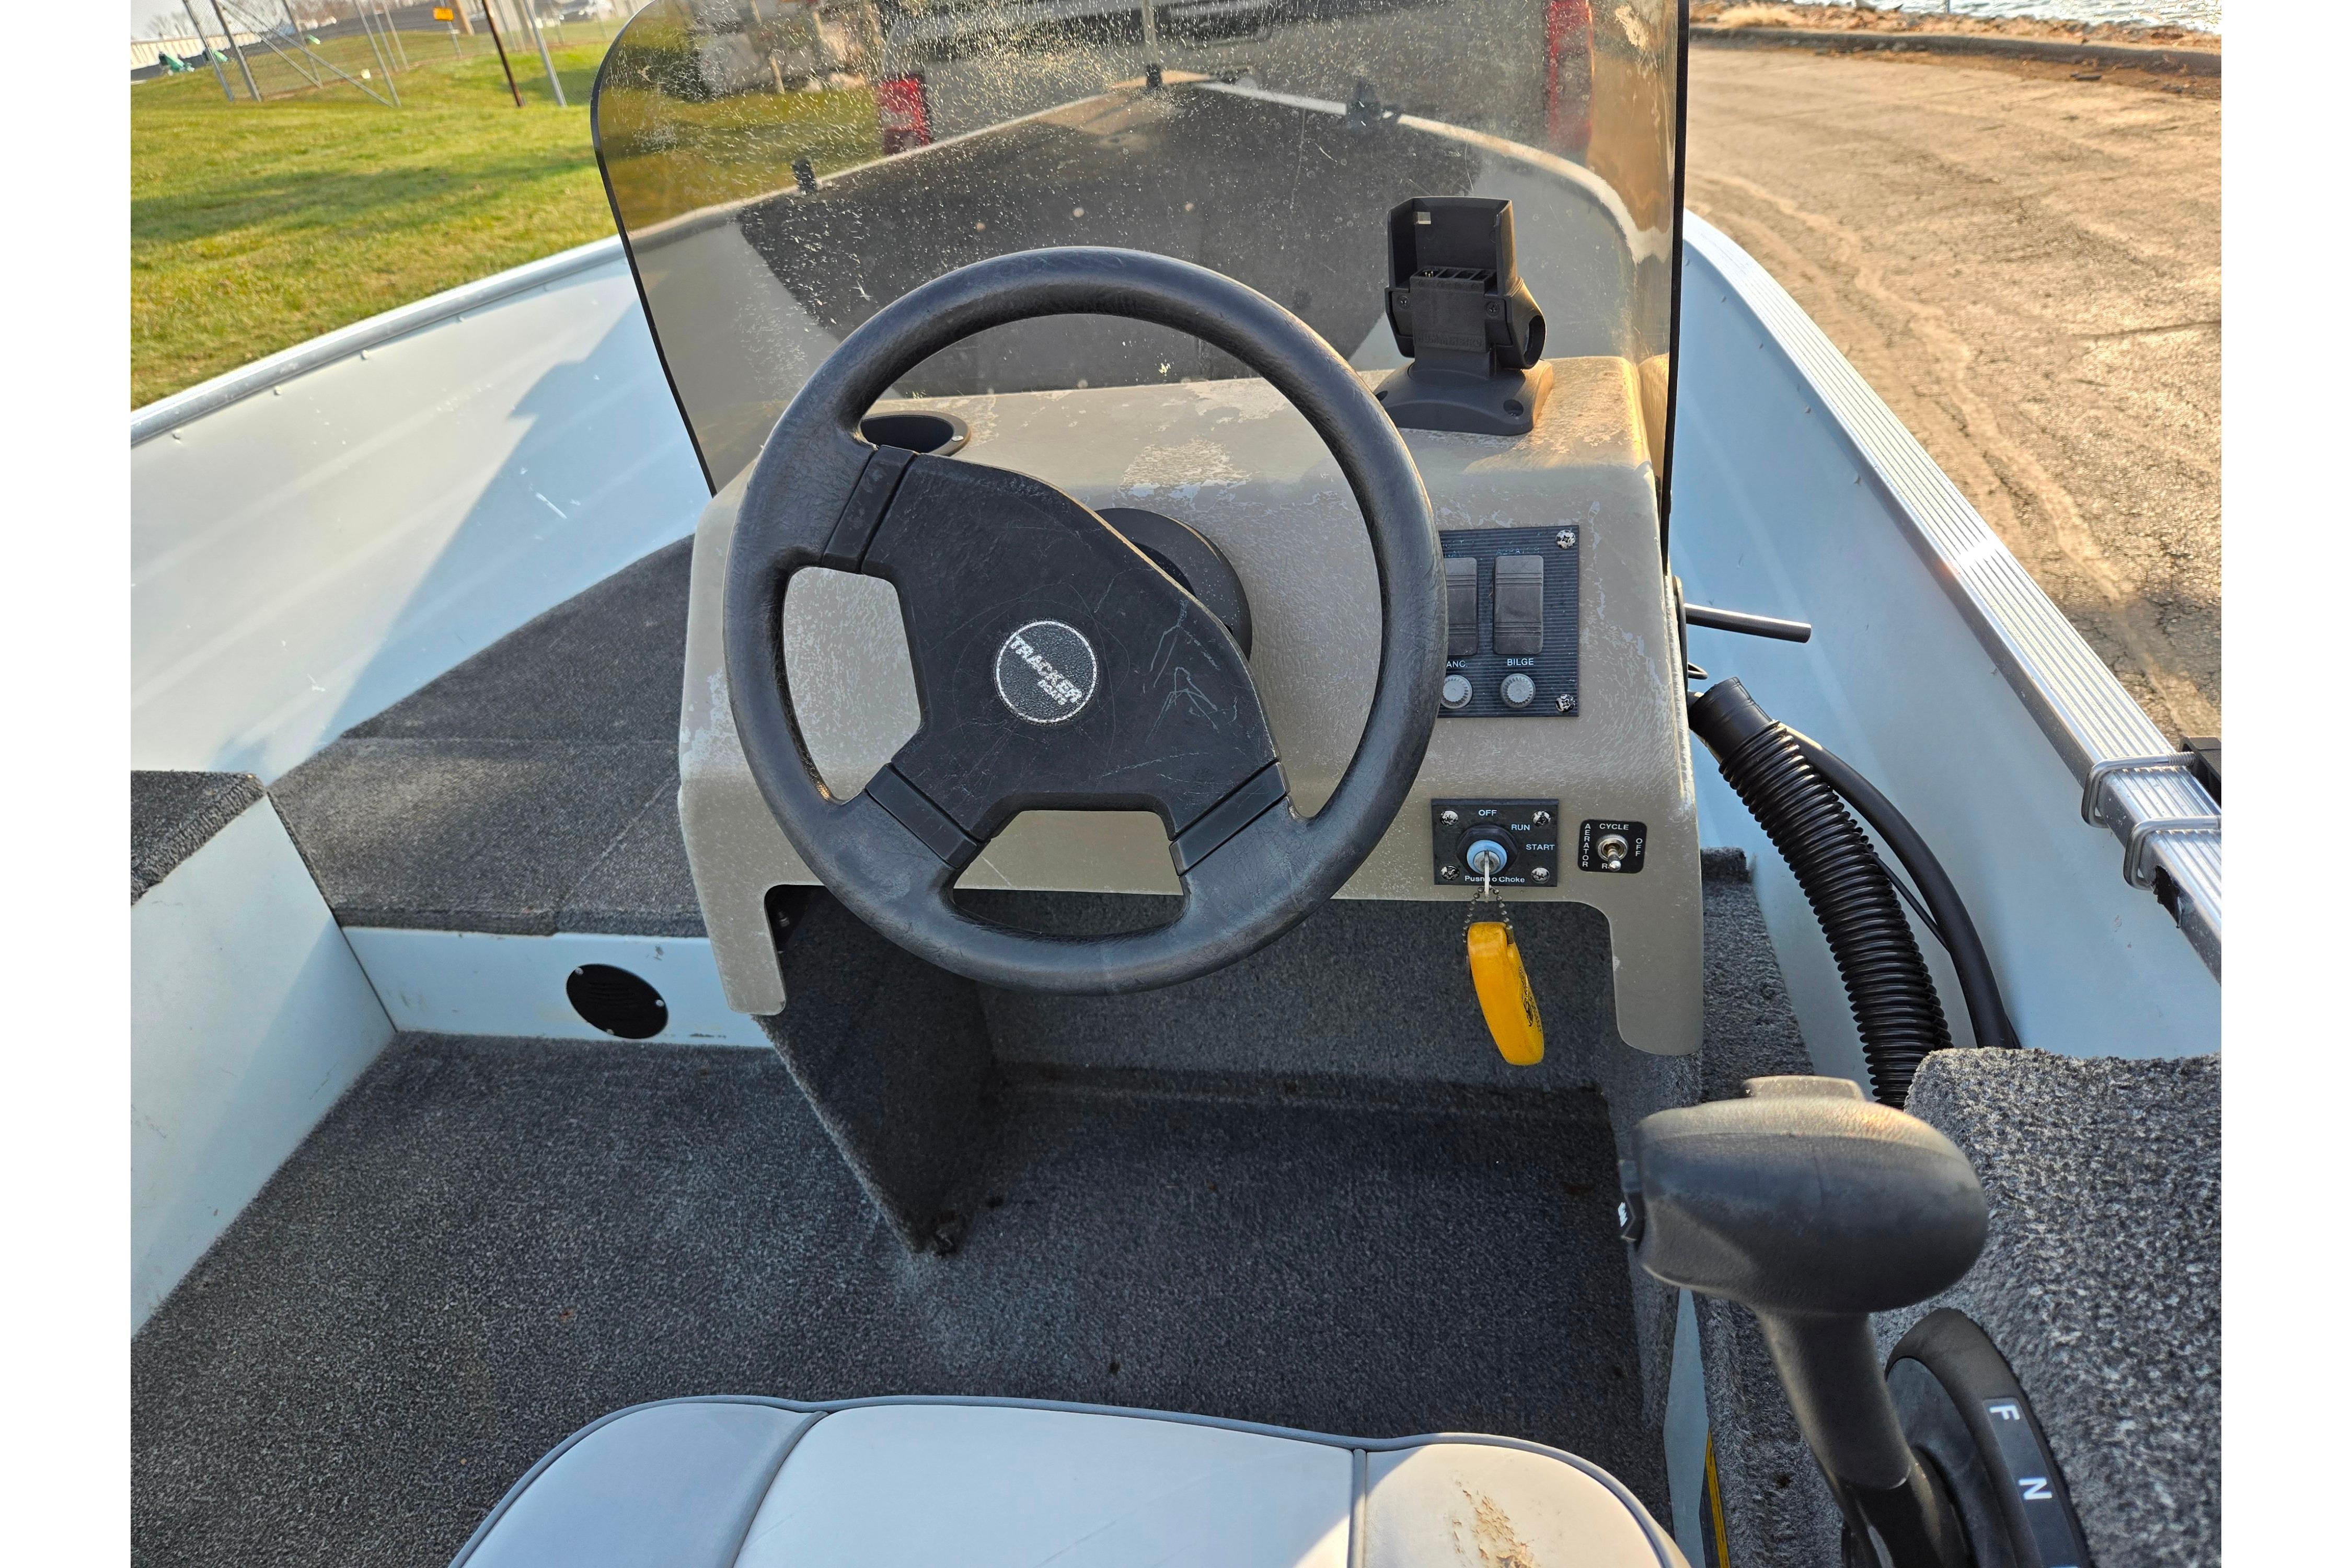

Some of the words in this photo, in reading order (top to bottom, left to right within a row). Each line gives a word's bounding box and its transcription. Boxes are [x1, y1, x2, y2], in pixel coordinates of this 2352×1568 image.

[1010, 635, 1082, 703] TRACKER
[1507, 658, 1535, 666] BILGE
[1582, 823, 1591, 868] AERATOR
[1990, 1405, 2020, 1420] F
[2019, 1477, 2053, 1500] N
